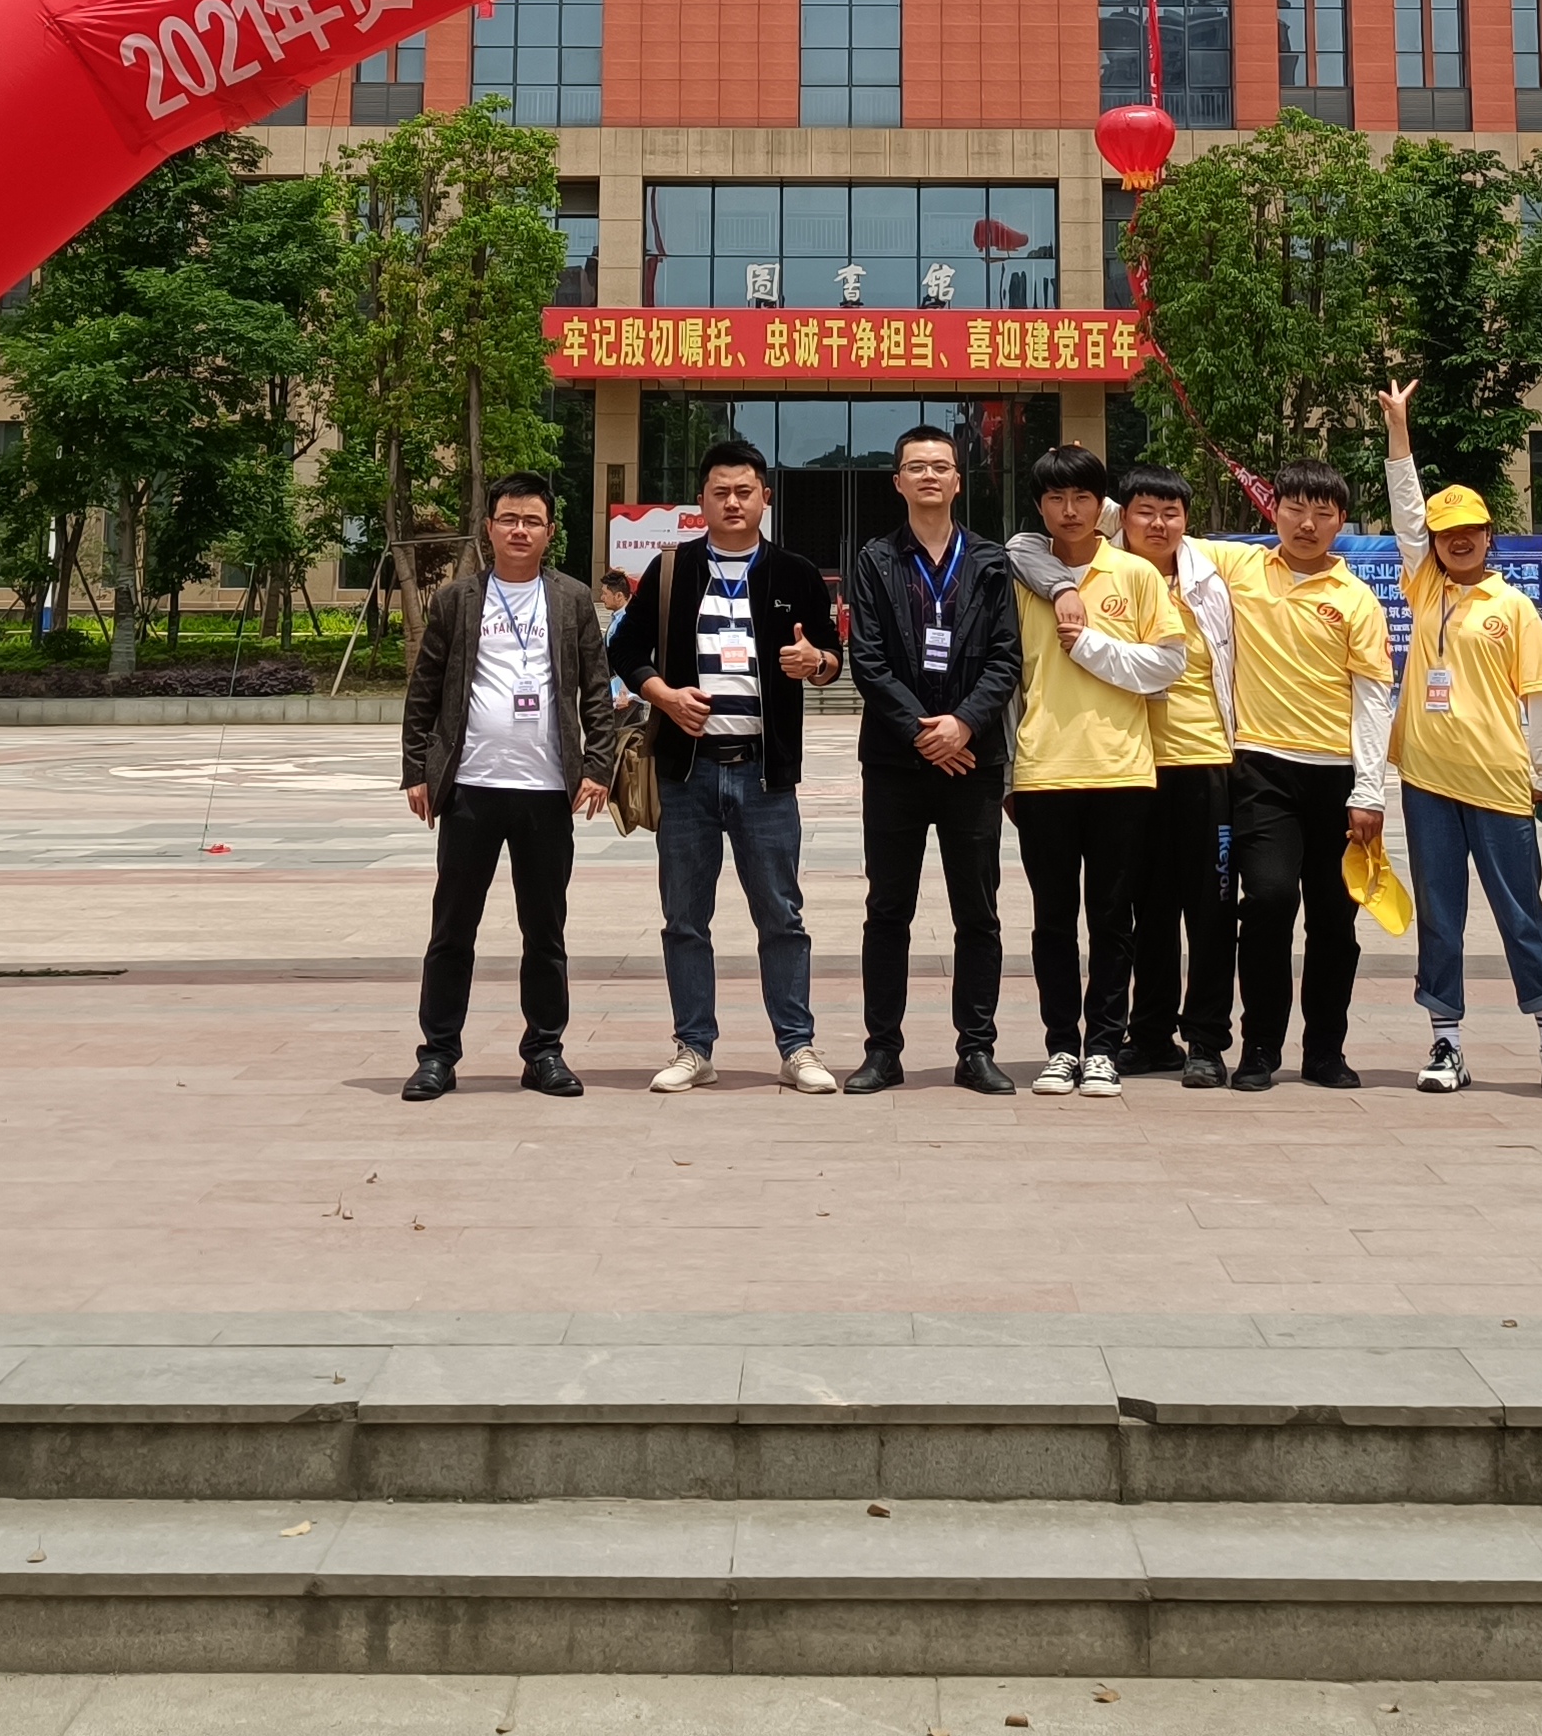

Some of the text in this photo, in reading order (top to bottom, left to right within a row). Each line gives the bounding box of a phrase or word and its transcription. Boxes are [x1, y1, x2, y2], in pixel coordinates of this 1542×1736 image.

[562, 317, 1139, 371] 牢记殷切嘱托、忠诚干净担当、喜迎建党百年
